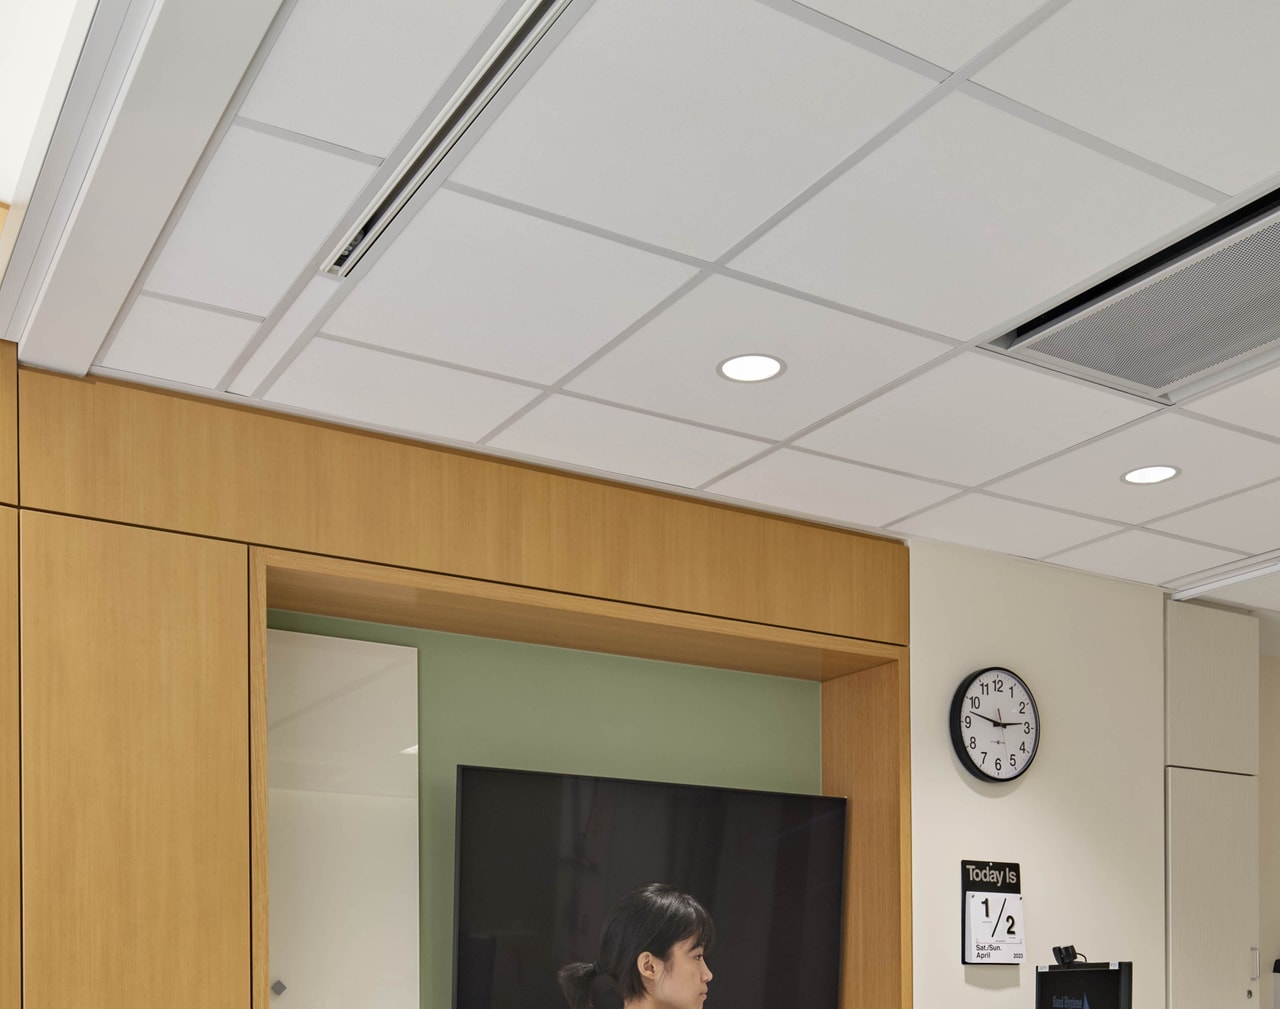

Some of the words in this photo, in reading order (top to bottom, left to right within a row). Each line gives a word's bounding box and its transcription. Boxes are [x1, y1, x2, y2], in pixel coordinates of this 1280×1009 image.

[979, 682, 989, 696] 11
[992, 679, 1004, 693] 12
[1009, 686, 1014, 699] 1
[969, 696, 981, 710] 10
[1018, 701, 1026, 714] 2
[964, 715, 972, 729] 9
[1023, 721, 1031, 735] 3
[969, 736, 977, 750] 8
[1019, 741, 1026, 754] 4
[980, 751, 988, 764] 7
[1009, 754, 1017, 767] 5
[994, 758, 1002, 771] 6
[966, 865, 1004, 887] Today
[1006, 868, 1017, 884] Is
[975, 944, 1002, 952] Sat./Sun.
[976, 952, 991, 960] April
